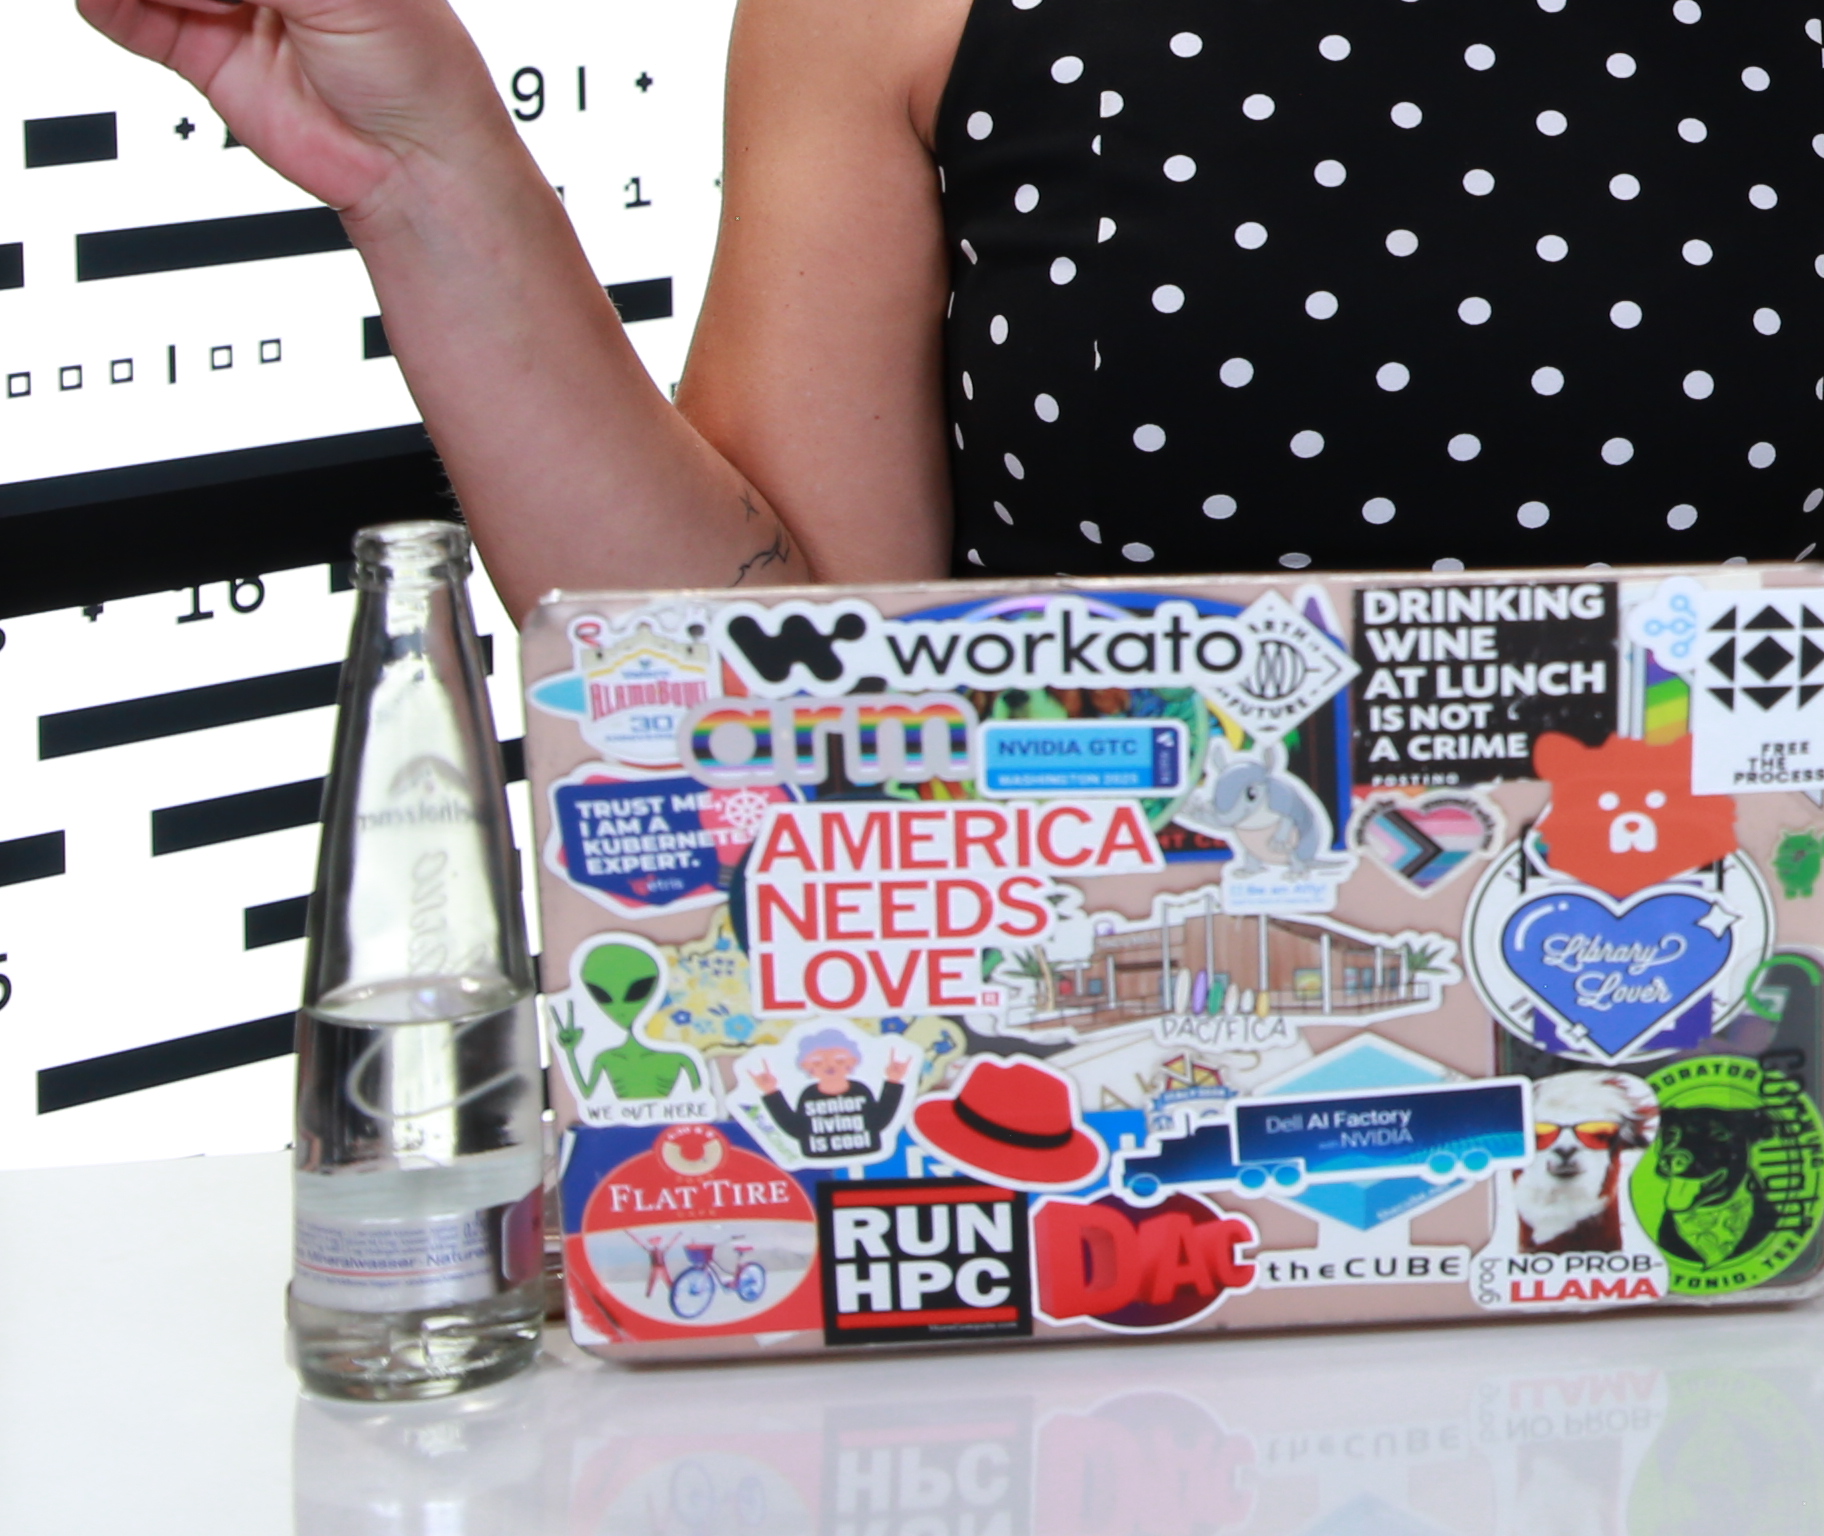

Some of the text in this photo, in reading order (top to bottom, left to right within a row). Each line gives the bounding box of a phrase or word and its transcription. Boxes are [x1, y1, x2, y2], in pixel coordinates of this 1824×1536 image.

[1364, 584, 1605, 625] DRINKING
[886, 610, 1242, 676] workato
[1367, 627, 1496, 663] WINE
[1364, 663, 1606, 701] AT LUNCH
[1369, 704, 1493, 732] IS NOT
[691, 704, 968, 777] arm
[999, 739, 1138, 757] NVIDIA GTC
[1370, 733, 1529, 763] A CRIME
[1761, 741, 1811, 757] FREE
[1748, 757, 1787, 772] THE
[575, 792, 723, 821] TRUST ME,
[579, 816, 671, 838] I AM A
[756, 806, 1154, 874] AMERICA
[586, 851, 700, 877] EXPERT.
[756, 876, 1051, 943] NEEDS
[1542, 932, 1688, 976] Library
[1574, 972, 1673, 1010] Lover
[804, 1094, 868, 1116] senior
[810, 1113, 865, 1135] living
[1266, 1107, 1413, 1135] Dell AI Factory
[809, 1132, 871, 1152] is cool
[1340, 1126, 1414, 1149] NVIDIA
[609, 1179, 790, 1214] FLAT TIRE
[832, 1201, 1014, 1260] RUN
[1507, 1252, 1664, 1275] NO PROB-
[836, 1257, 1013, 1314] HPC
